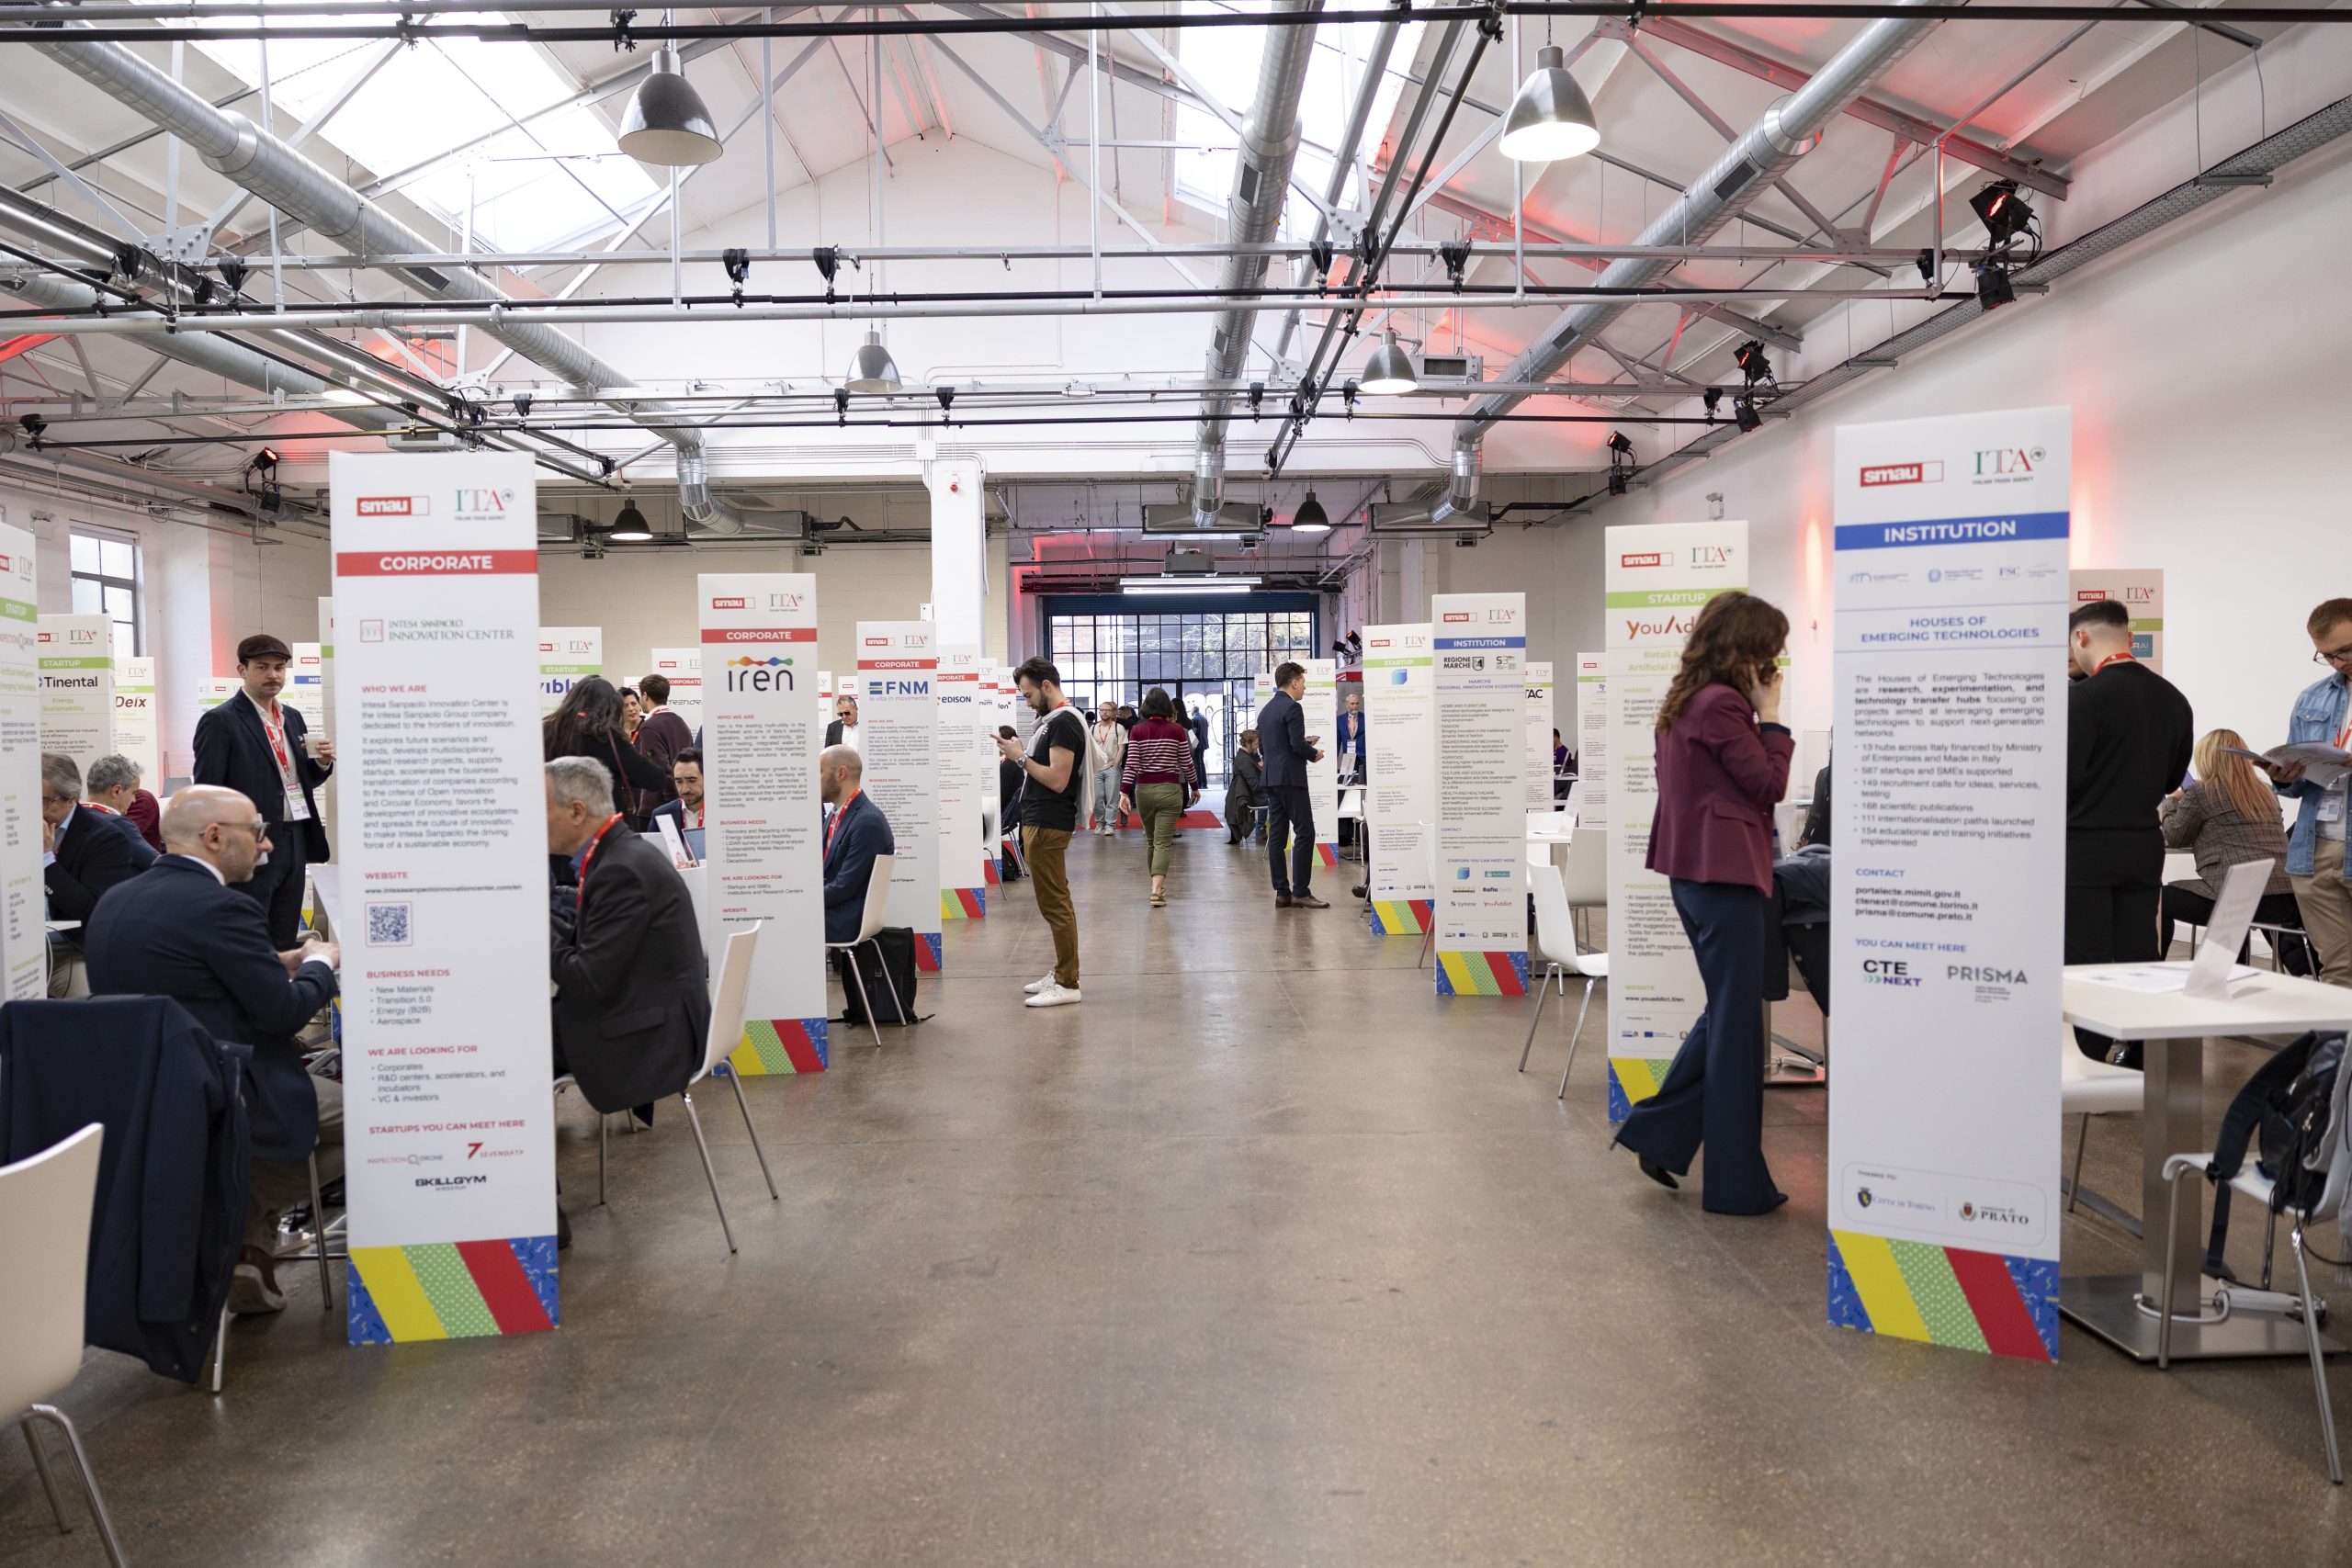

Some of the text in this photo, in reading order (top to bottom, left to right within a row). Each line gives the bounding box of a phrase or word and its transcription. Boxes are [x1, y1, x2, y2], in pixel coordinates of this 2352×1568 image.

[1974, 449, 2033, 475] ITA
[1864, 466, 1918, 483] smau
[455, 490, 504, 511] ITA
[360, 501, 408, 512] smau
[1885, 520, 2015, 543] INSTITUTION
[1692, 548, 1726, 563] ITA
[380, 556, 492, 570] CORPORATE
[1648, 593, 1706, 604] STARTUP
[2126, 587, 2150, 599] ITA
[770, 594, 798, 606] ITA
[1489, 610, 1512, 620] ITA
[1627, 615, 1694, 639] youAd
[1911, 616, 1987, 628] HOUSES OF
[70, 630, 92, 640] ITA
[389, 630, 514, 641] INNOVATION CENTER
[905, 635, 924, 644] ITA
[1405, 636, 1422, 645] ITA
[1861, 628, 2039, 643] EMERGING TECHNOLOGIES
[570, 642, 589, 650] ITA
[44, 676, 98, 688] Tinental
[729, 670, 793, 691] iren
[1933, 673, 1976, 683] Emerging
[1984, 672, 2044, 682] Technologies
[887, 681, 928, 694] FNM
[1879, 685, 1922, 694] research,
[1932, 684, 2015, 693] experimentation,
[1855, 697, 1906, 705] technology
[1856, 869, 1904, 877] CONTACT
[1881, 940, 1902, 949] CAN
[1906, 942, 1934, 951] MEET
[1938, 943, 1966, 952] HERE
[1863, 960, 1907, 975] CTE
[367, 971, 414, 979] BUSINESS
[1947, 966, 2027, 984] PRISMA
[1884, 976, 1922, 987] NEXT
[377, 1007, 405, 1016] Energy
[377, 1017, 420, 1026] Aerospace
[410, 1046, 455, 1055] LOOKING
[378, 1063, 423, 1072] Corporates
[378, 1084, 420, 1093] incubators
[402, 1093, 439, 1101] investors
[369, 1125, 419, 1134] STARTUPS
[415, 1176, 486, 1187] SKILLGYM
[1981, 1211, 2029, 1225] PRATO
